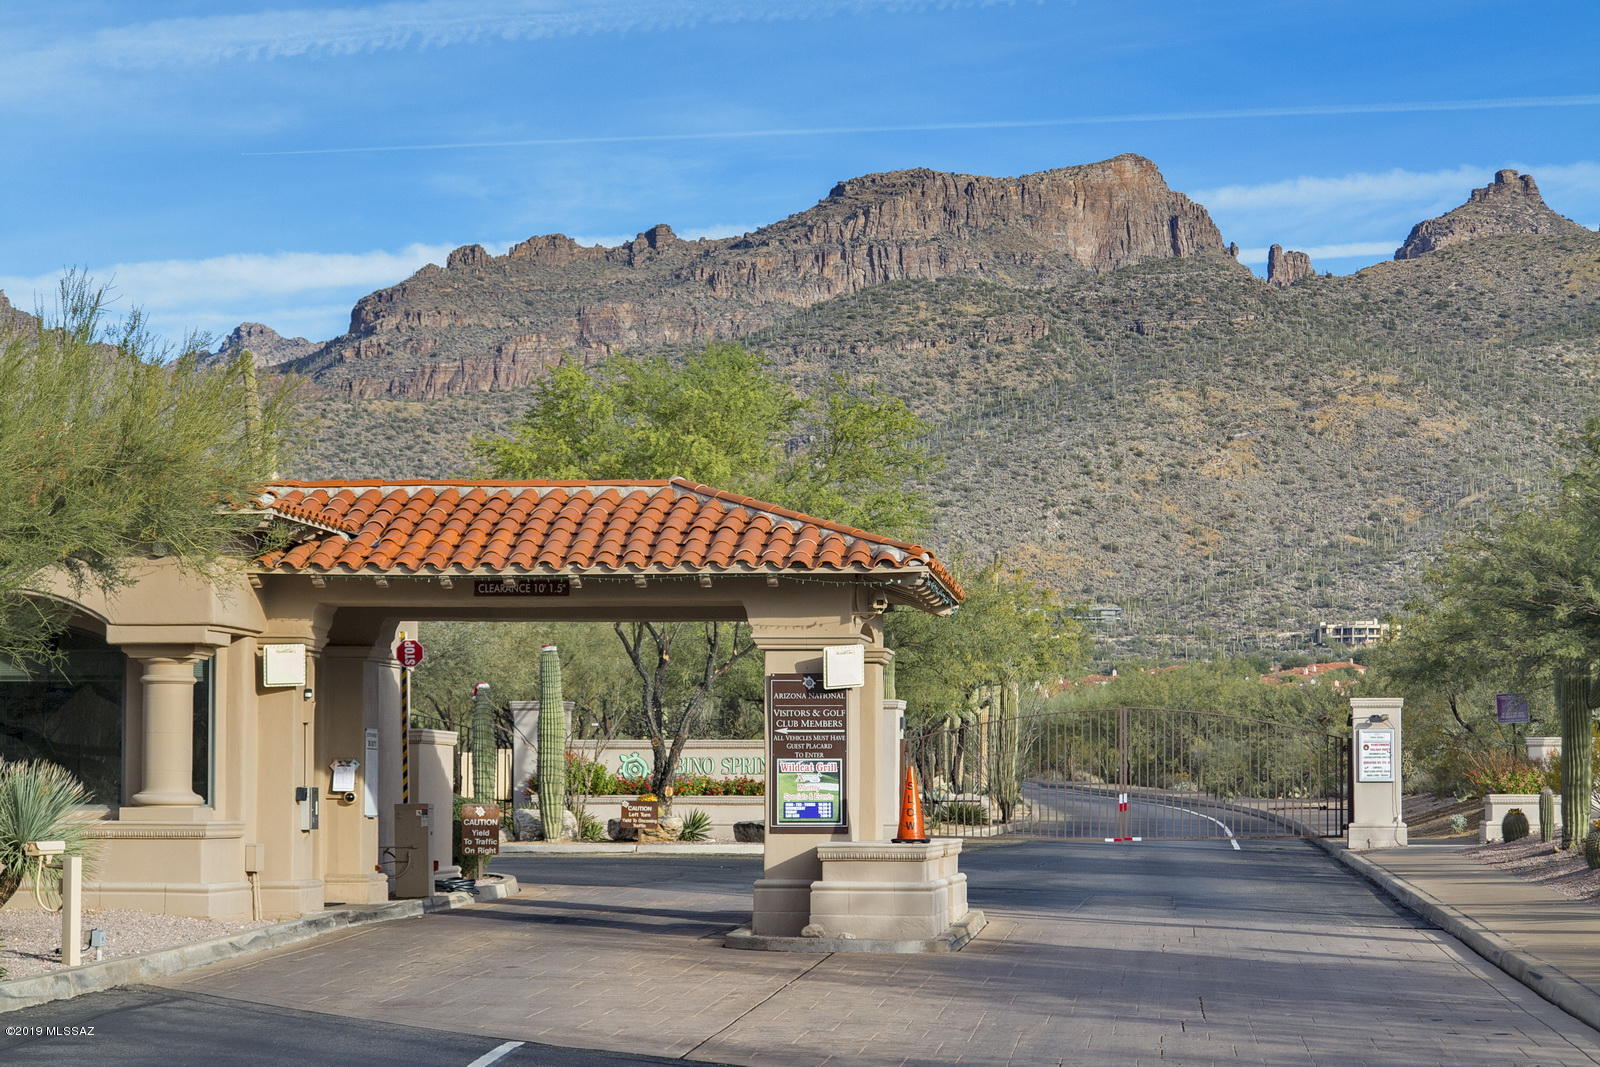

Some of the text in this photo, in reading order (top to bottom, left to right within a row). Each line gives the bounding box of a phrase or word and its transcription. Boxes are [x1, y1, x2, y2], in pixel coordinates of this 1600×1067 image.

[478, 583, 531, 593] CLEARANCE
[404, 641, 415, 665] STOP
[773, 709, 846, 717] VISITORS & GOLF
[775, 720, 843, 728] CLUB MEMBERS
[673, 757, 715, 775] BINO
[780, 762, 838, 772] Wildcat Grill
[905, 781, 915, 831] SLOW
[477, 847, 497, 855] Right
